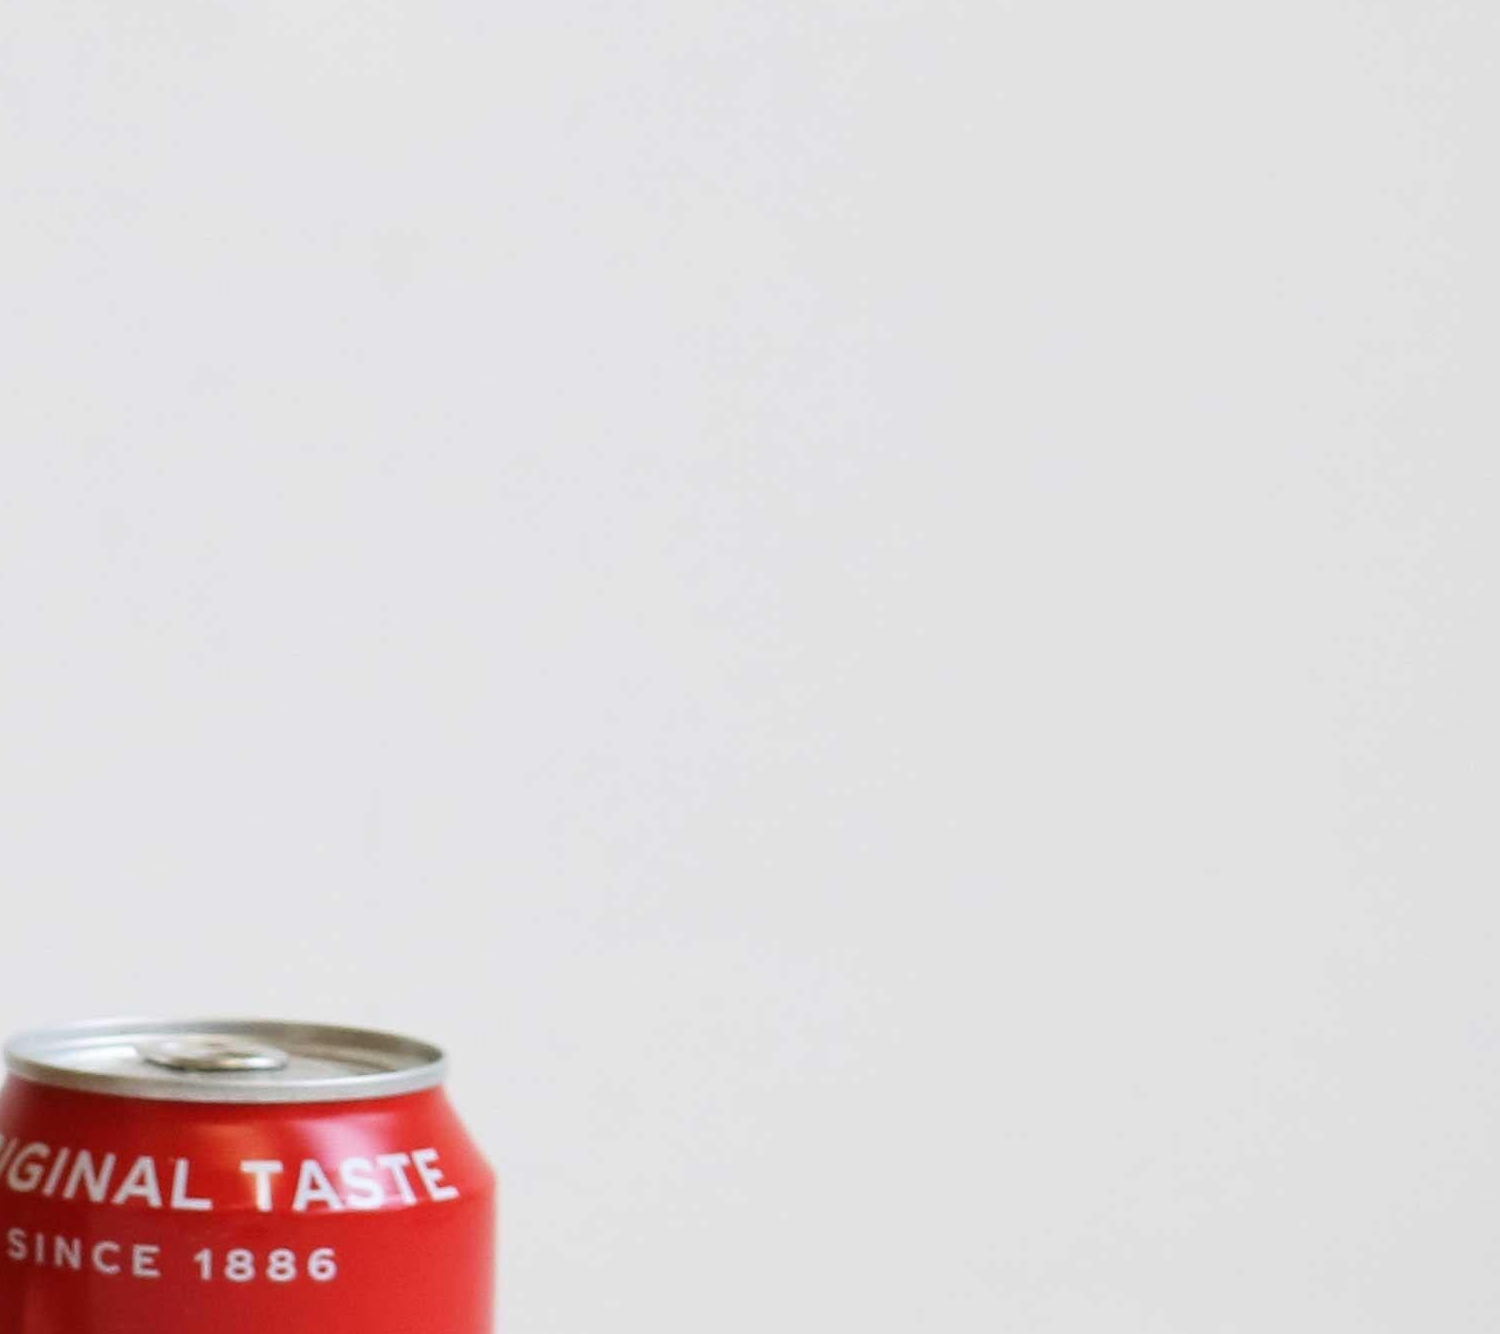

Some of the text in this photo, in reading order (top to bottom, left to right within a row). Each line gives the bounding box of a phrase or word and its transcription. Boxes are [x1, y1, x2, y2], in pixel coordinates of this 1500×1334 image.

[239, 1147, 461, 1213] TASTE
[6, 1226, 339, 1282] SINCE 1886
